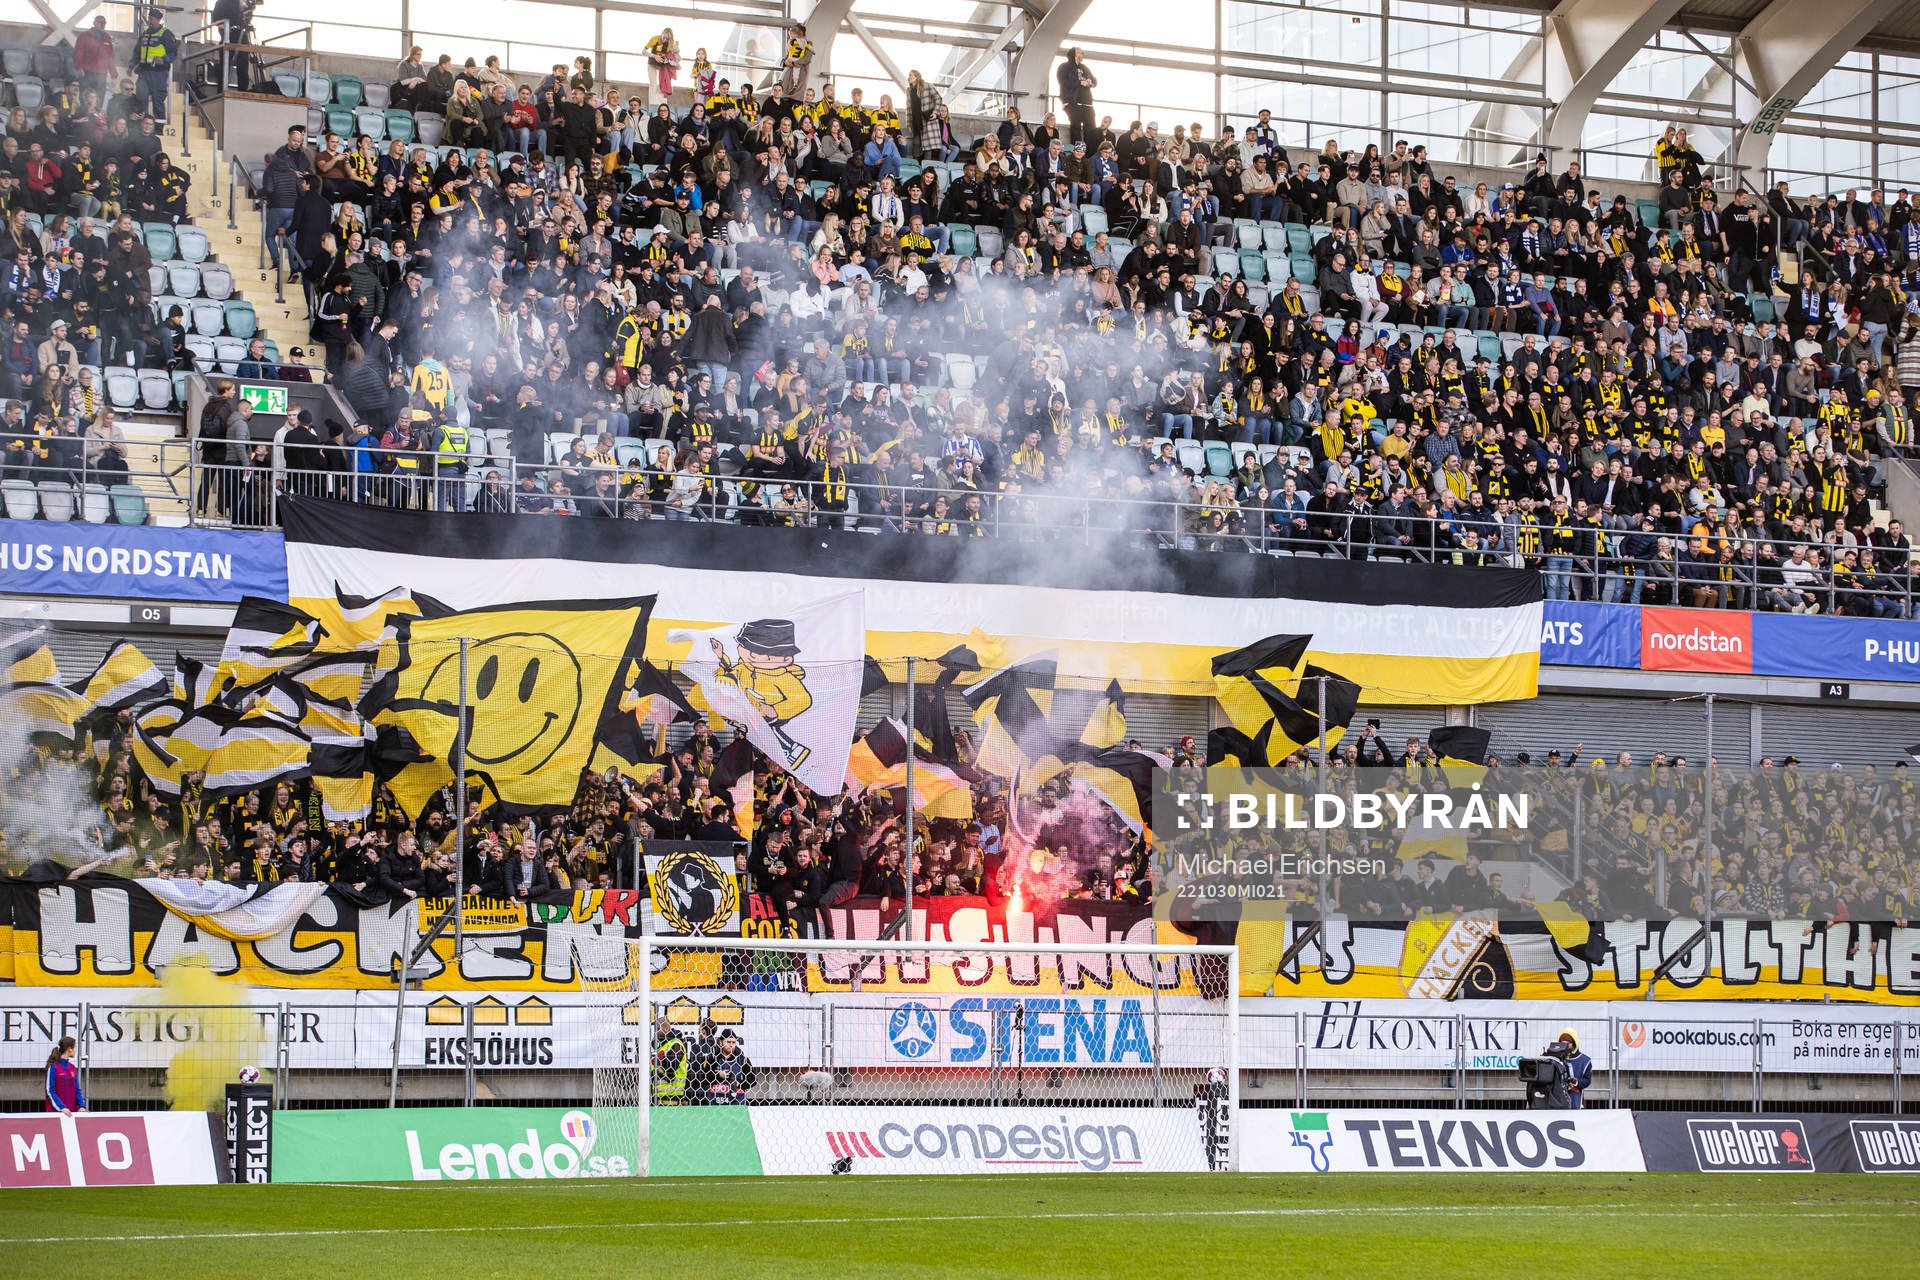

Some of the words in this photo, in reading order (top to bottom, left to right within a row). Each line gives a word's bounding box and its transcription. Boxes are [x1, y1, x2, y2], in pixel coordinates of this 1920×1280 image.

[1771, 98, 1793, 109] B2
[1762, 109, 1784, 121] B3
[165, 128, 176, 137] 12
[1753, 121, 1776, 135] B4
[187, 163, 197, 172] 11
[211, 200, 221, 208] 10
[235, 236, 242, 244] 9
[260, 273, 267, 281] 8
[283, 311, 290, 319] 7
[309, 348, 315, 357] 6
[427, 371, 443, 391] 25
[152, 454, 158, 463] 3
[62, 545, 232, 580] NORDSTAN
[1650, 628, 1742, 654] nordstan
[1865, 638, 1920, 664] P-HU
[1829, 685, 1842, 696] A3
[2, 1010, 324, 1043] ENFASTIGTER
[950, 998, 1153, 1063] STENA
[1793, 1019, 1832, 1038] Boka
[1838, 1023, 1857, 1038] en
[1863, 1024, 1901, 1043] ege
[1652, 1028, 1776, 1047] bookabus.com
[425, 1031, 553, 1066] EKSJÖHUS
[1794, 1041, 1809, 1060] på
[1814, 1044, 1860, 1058] mindre
[1864, 1044, 1880, 1058] än
[246, 1097, 268, 1183] SELECT
[1344, 1120, 1586, 1168] TEKNOS
[1697, 1120, 1780, 1165] weber
